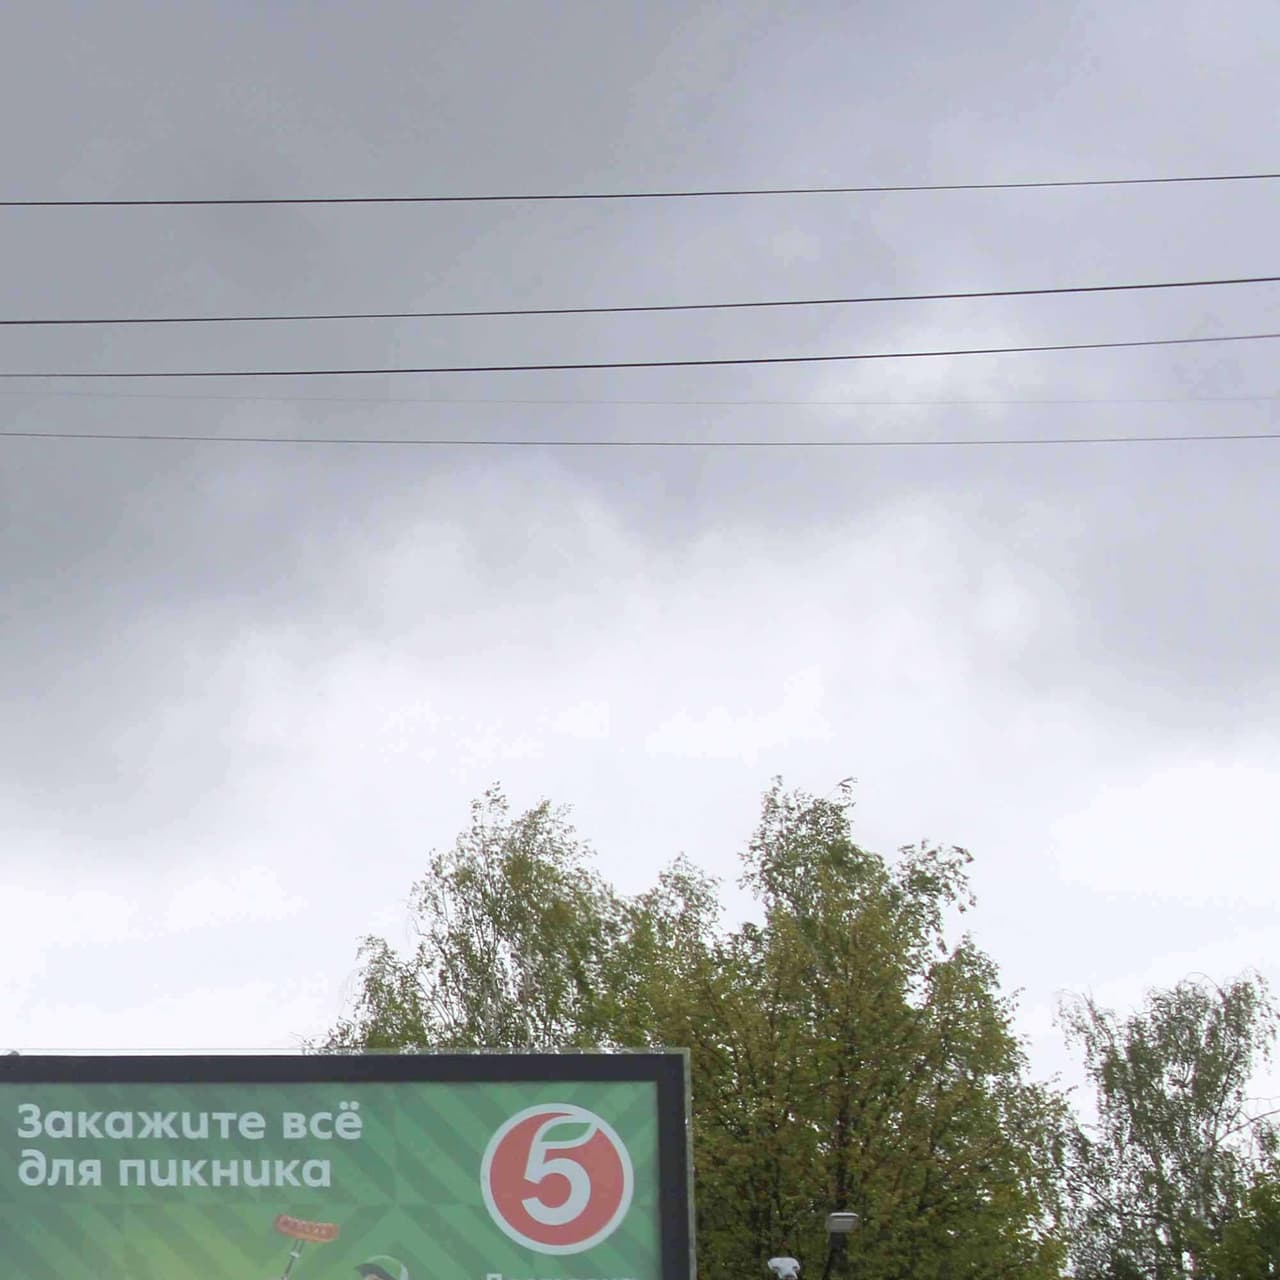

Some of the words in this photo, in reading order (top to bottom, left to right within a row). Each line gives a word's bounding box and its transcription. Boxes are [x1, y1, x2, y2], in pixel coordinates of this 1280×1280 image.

[16, 1103, 267, 1140] Закажите
[283, 1101, 364, 1140] всё
[17, 1150, 103, 1188] для
[119, 1157, 332, 1188] пикника
